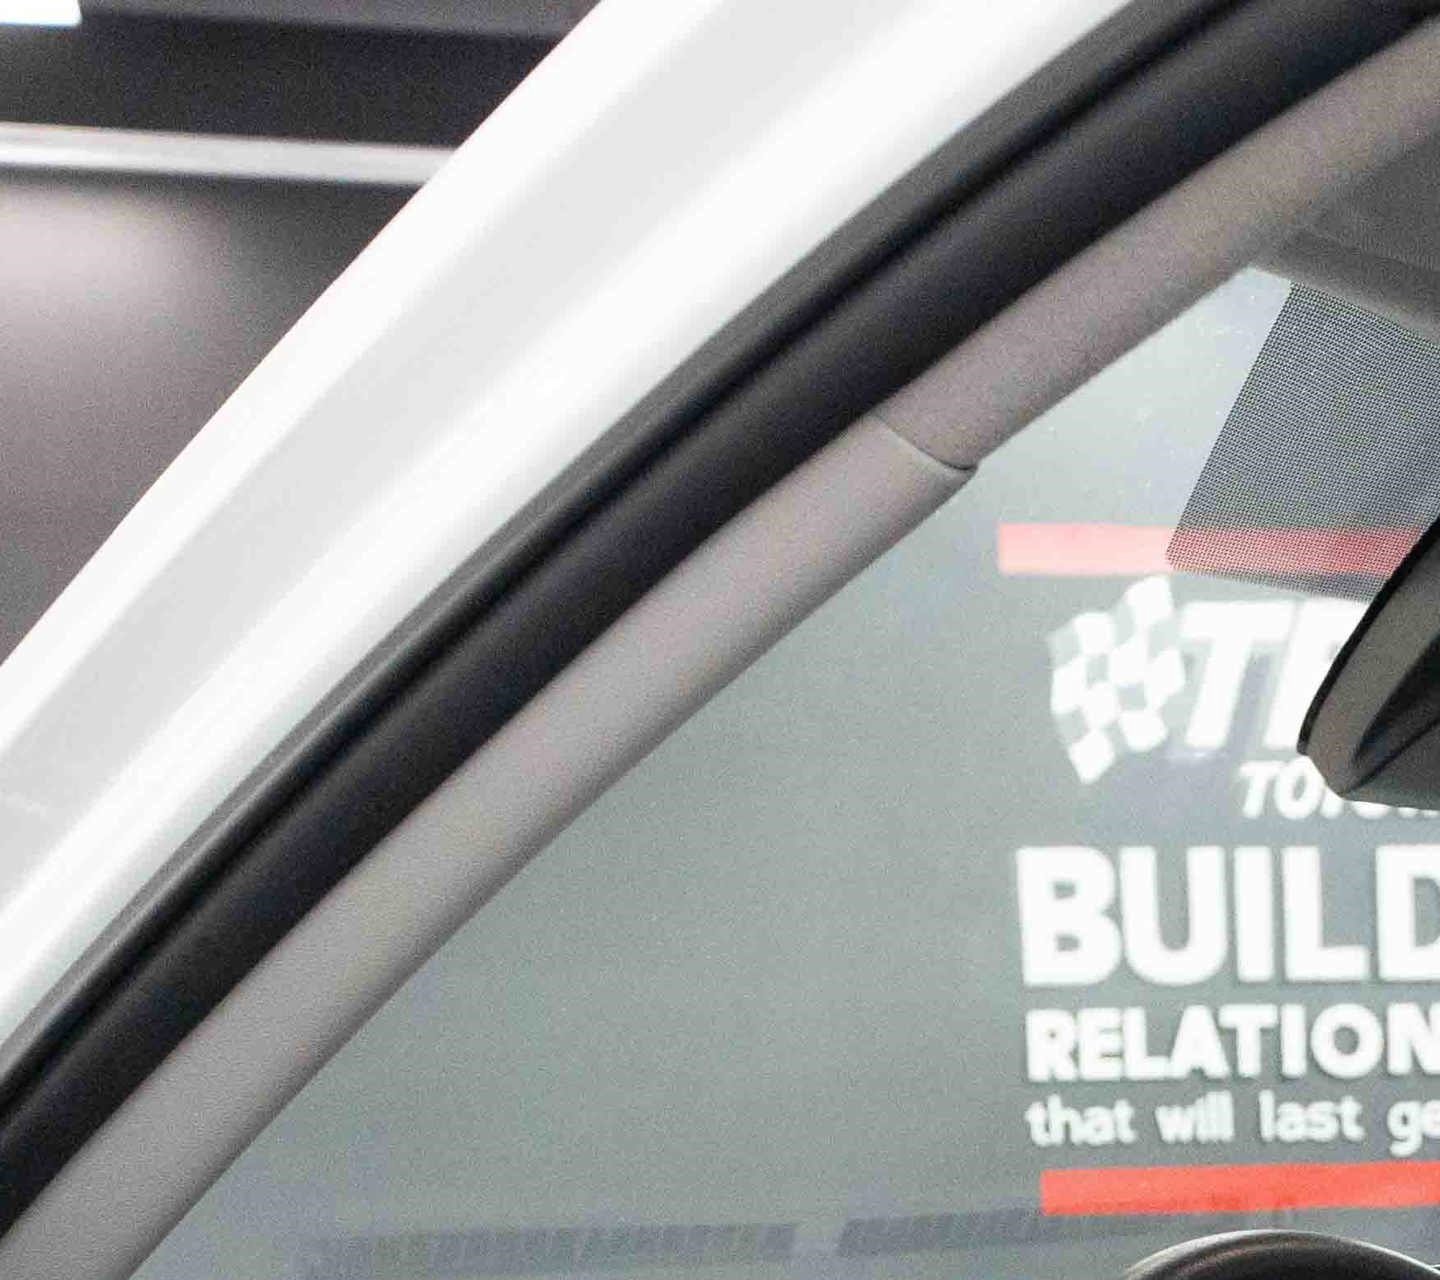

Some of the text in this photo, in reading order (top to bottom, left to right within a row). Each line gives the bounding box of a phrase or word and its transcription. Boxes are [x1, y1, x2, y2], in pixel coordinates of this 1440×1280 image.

[1025, 1093, 1135, 1148] that
[1157, 1090, 1234, 1144] will
[1259, 1088, 1363, 1144] last
